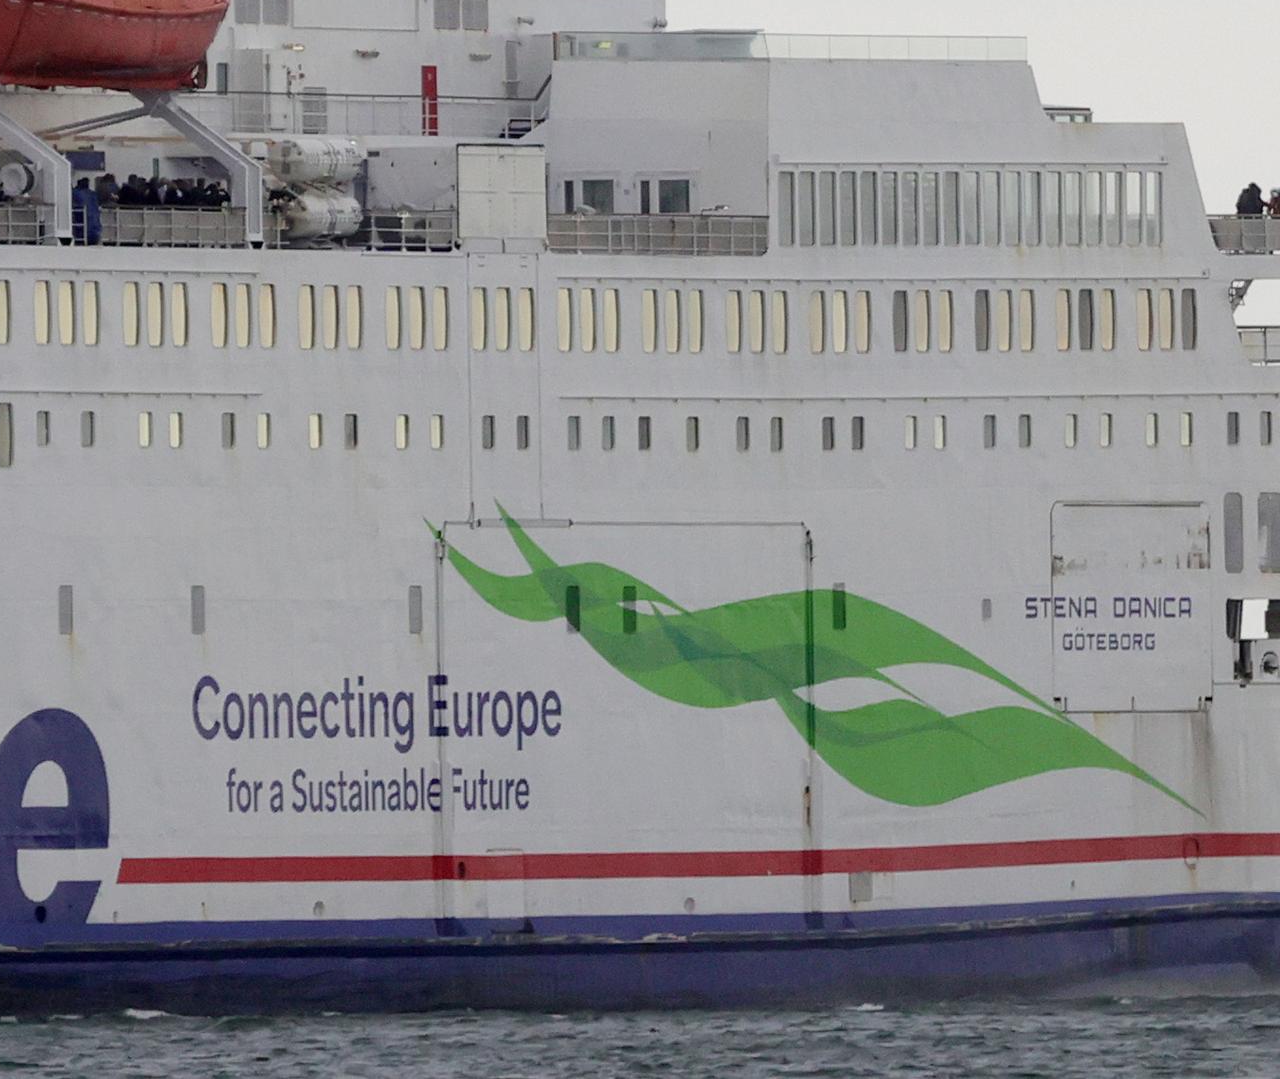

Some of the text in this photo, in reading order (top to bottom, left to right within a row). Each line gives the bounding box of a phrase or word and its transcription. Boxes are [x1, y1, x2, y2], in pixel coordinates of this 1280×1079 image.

[1025, 596, 1192, 619] STENA DANICA
[1062, 626, 1156, 651] GÖTEBORG
[191, 673, 563, 754] Connecting Europe
[226, 767, 263, 813] for
[269, 780, 284, 813] a
[291, 767, 443, 813] Sustainable
